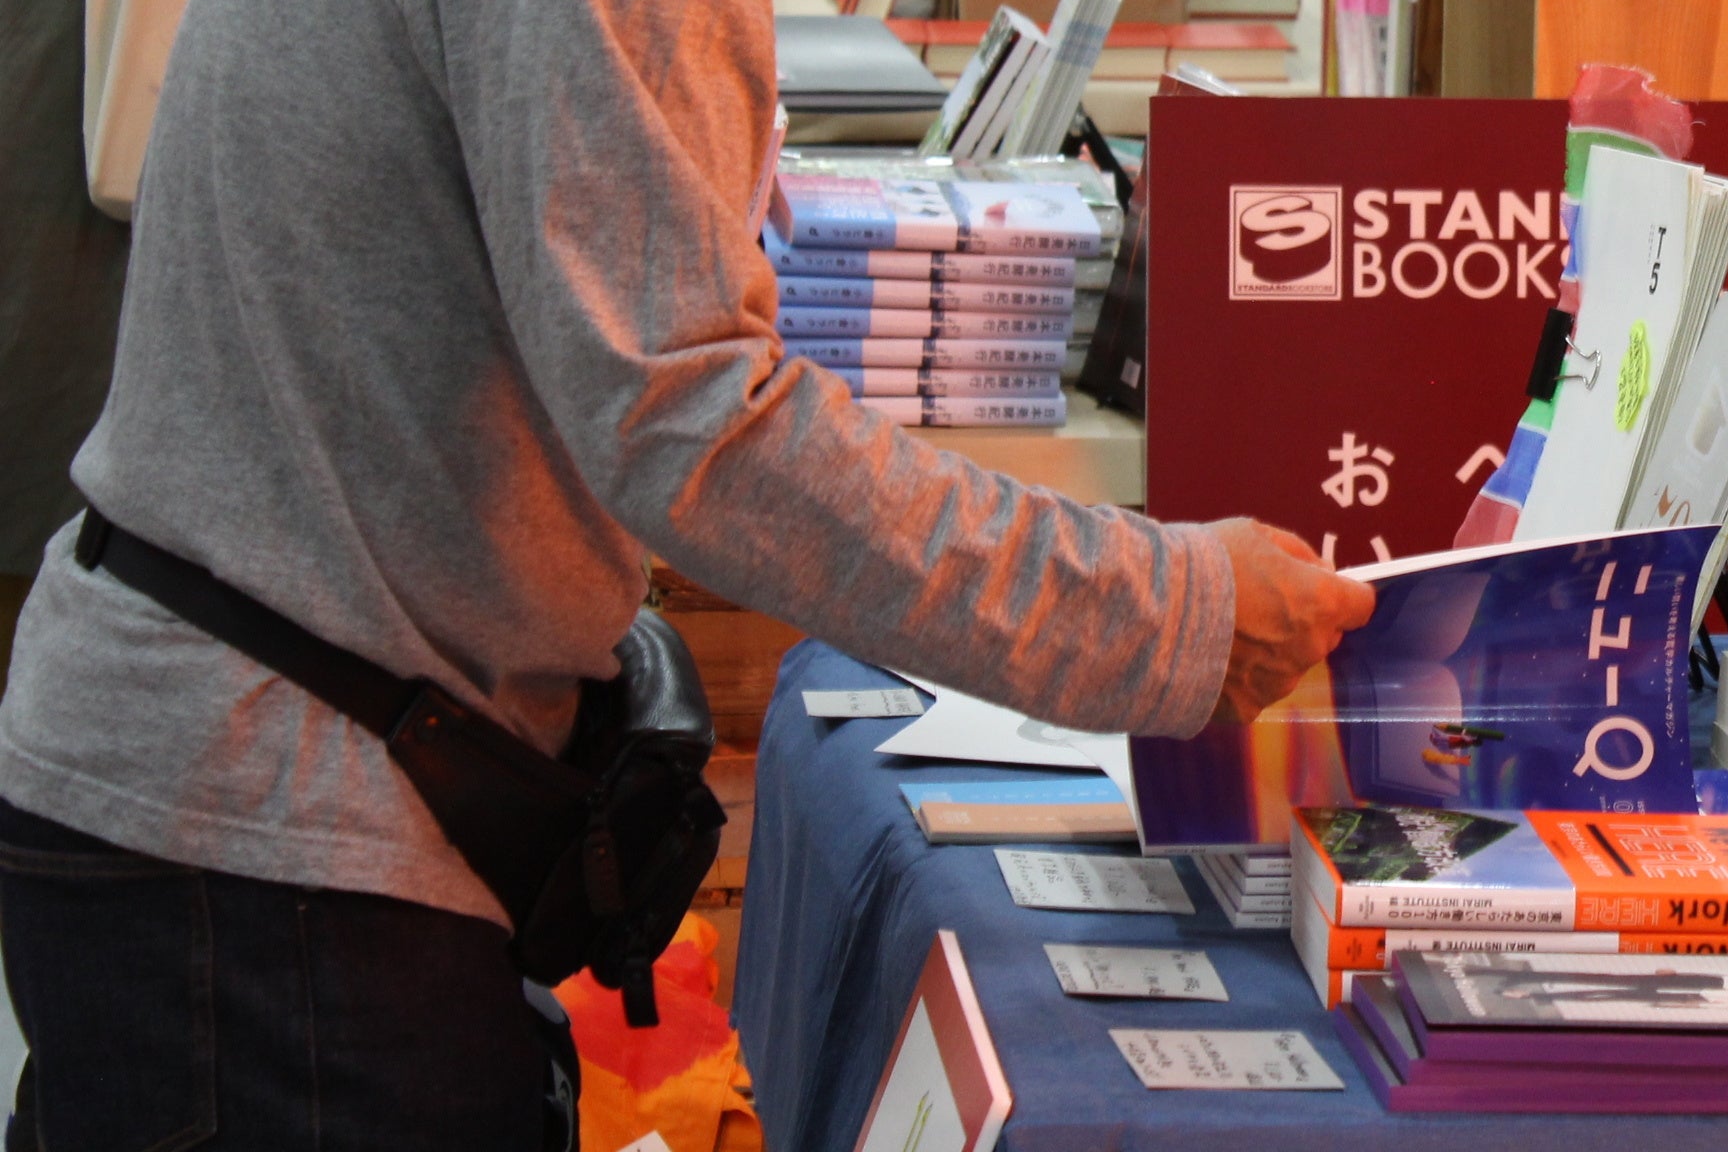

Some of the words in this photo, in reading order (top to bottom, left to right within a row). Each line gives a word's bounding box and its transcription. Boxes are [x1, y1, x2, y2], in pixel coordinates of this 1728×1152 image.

[1402, 897, 1459, 907] INSTITUTE
[1462, 898, 1493, 907] MIRAI
[1580, 897, 1660, 925] HERE
[1446, 941, 1502, 951] INSTITUTE
[1505, 941, 1536, 951] MIRAI
